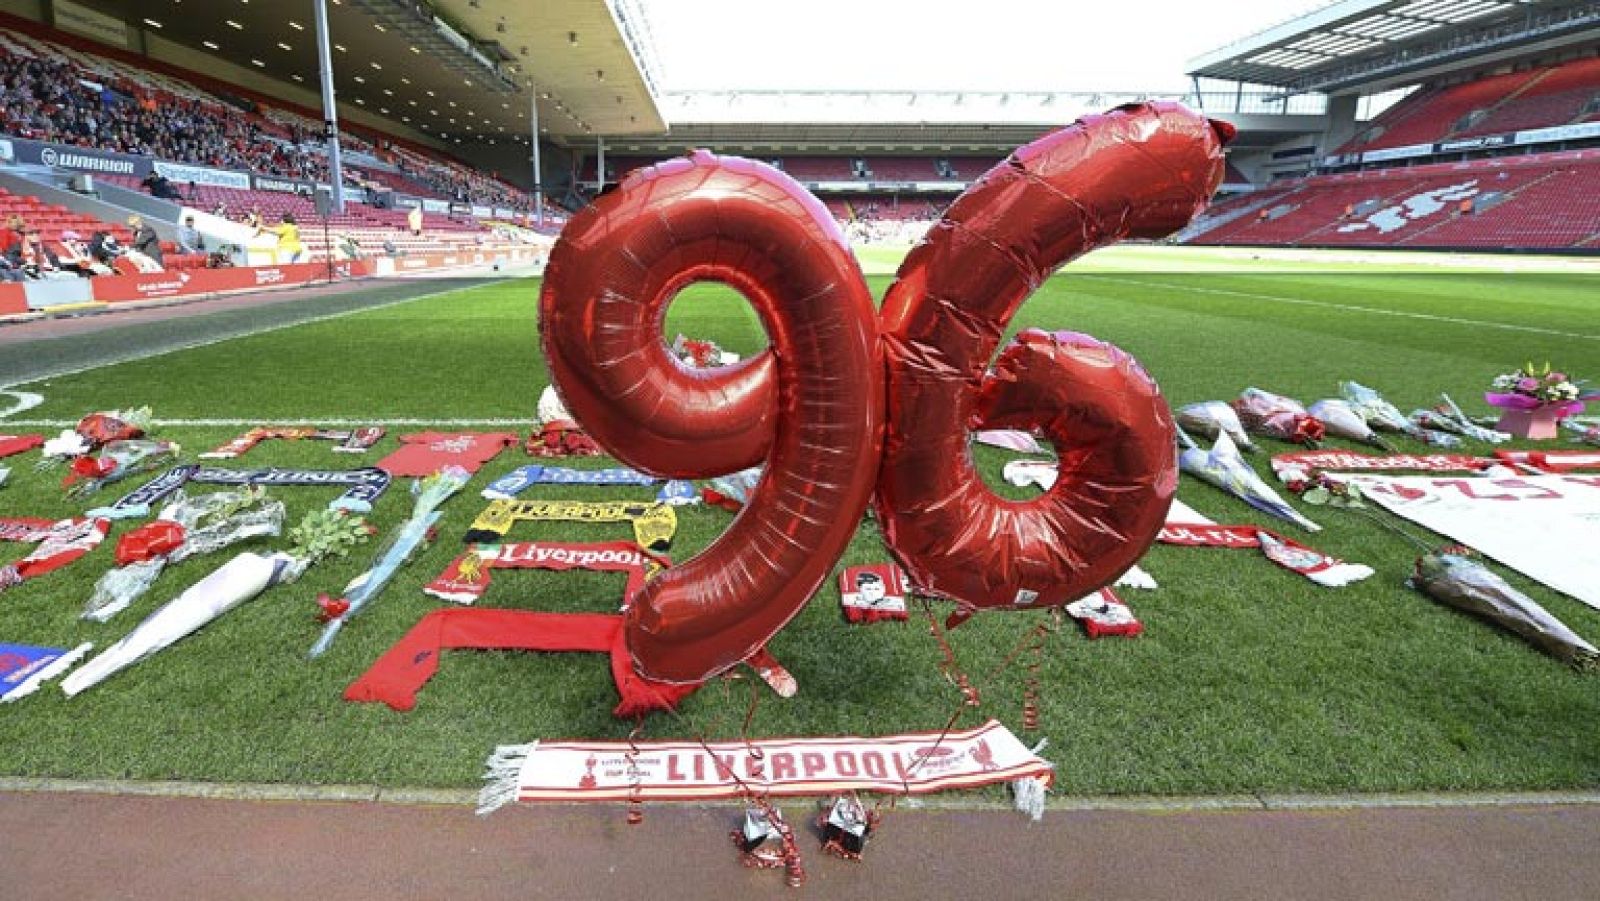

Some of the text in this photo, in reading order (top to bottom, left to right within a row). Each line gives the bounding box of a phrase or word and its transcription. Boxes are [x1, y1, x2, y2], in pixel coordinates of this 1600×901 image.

[59, 153, 135, 175] WARRIOR
[538, 100, 1237, 685] 96
[499, 544, 642, 566] Liverpool
[666, 750, 918, 782] LIVERPOOL
